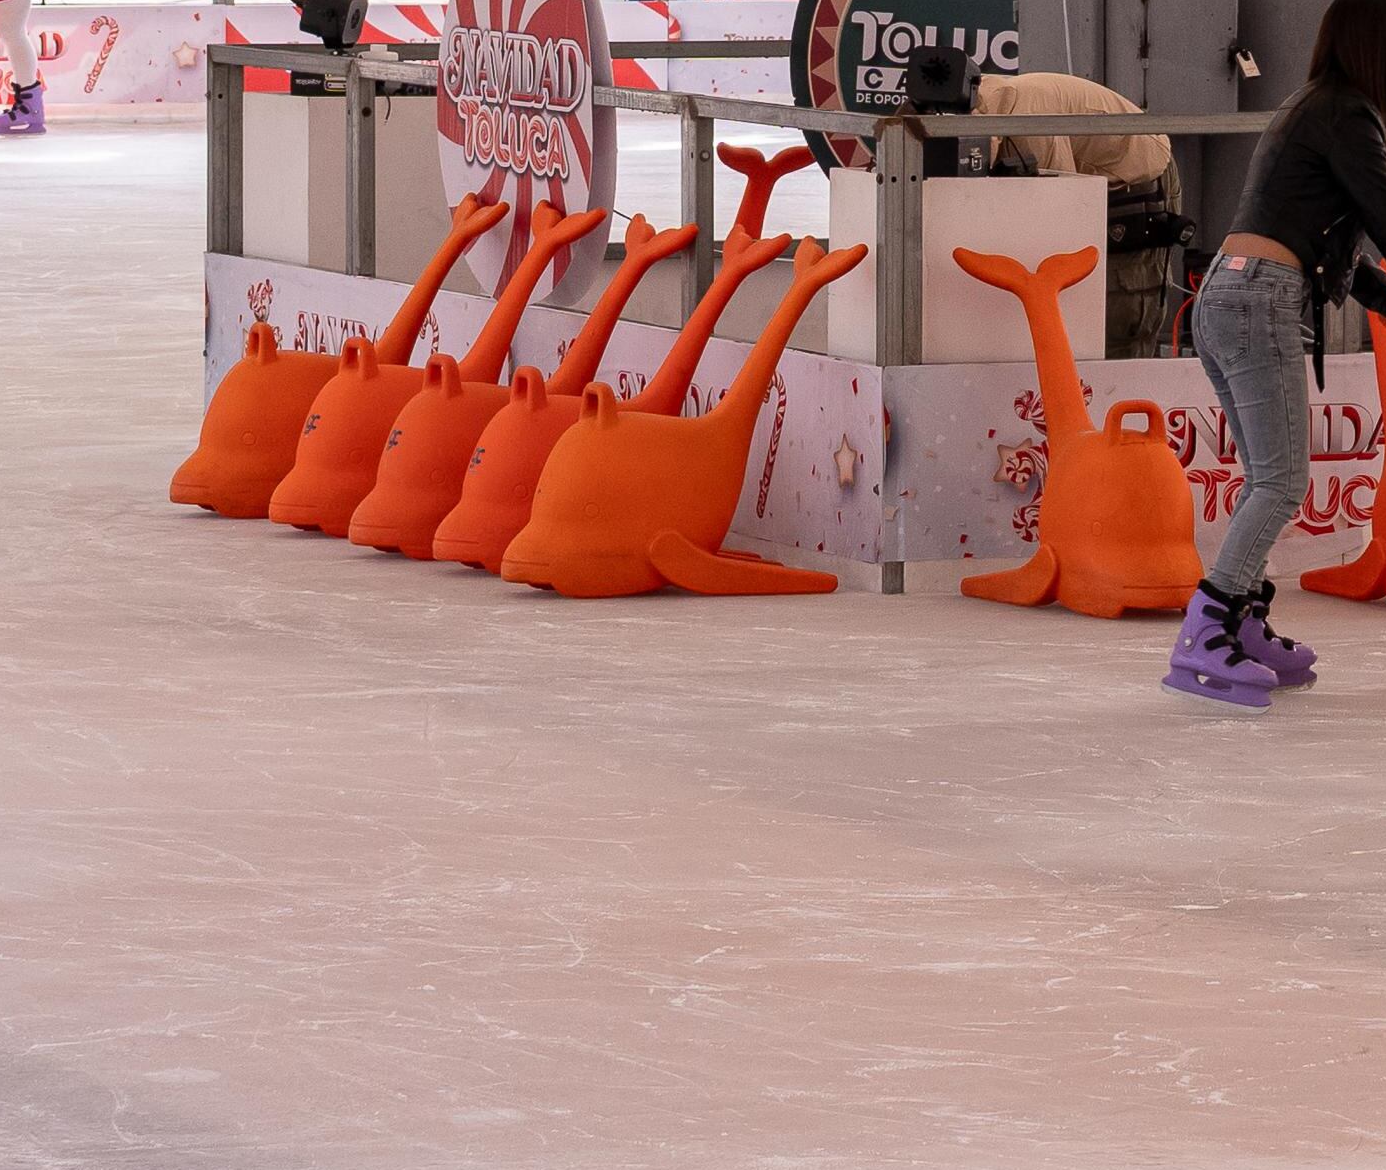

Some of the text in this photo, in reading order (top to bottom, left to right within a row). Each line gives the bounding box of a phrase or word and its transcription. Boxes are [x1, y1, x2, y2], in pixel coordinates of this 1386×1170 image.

[445, 29, 585, 110] NAVIDAD
[851, 10, 1019, 71] TOUC
[855, 93, 872, 104] DE
[459, 99, 568, 177] TOLUCA
